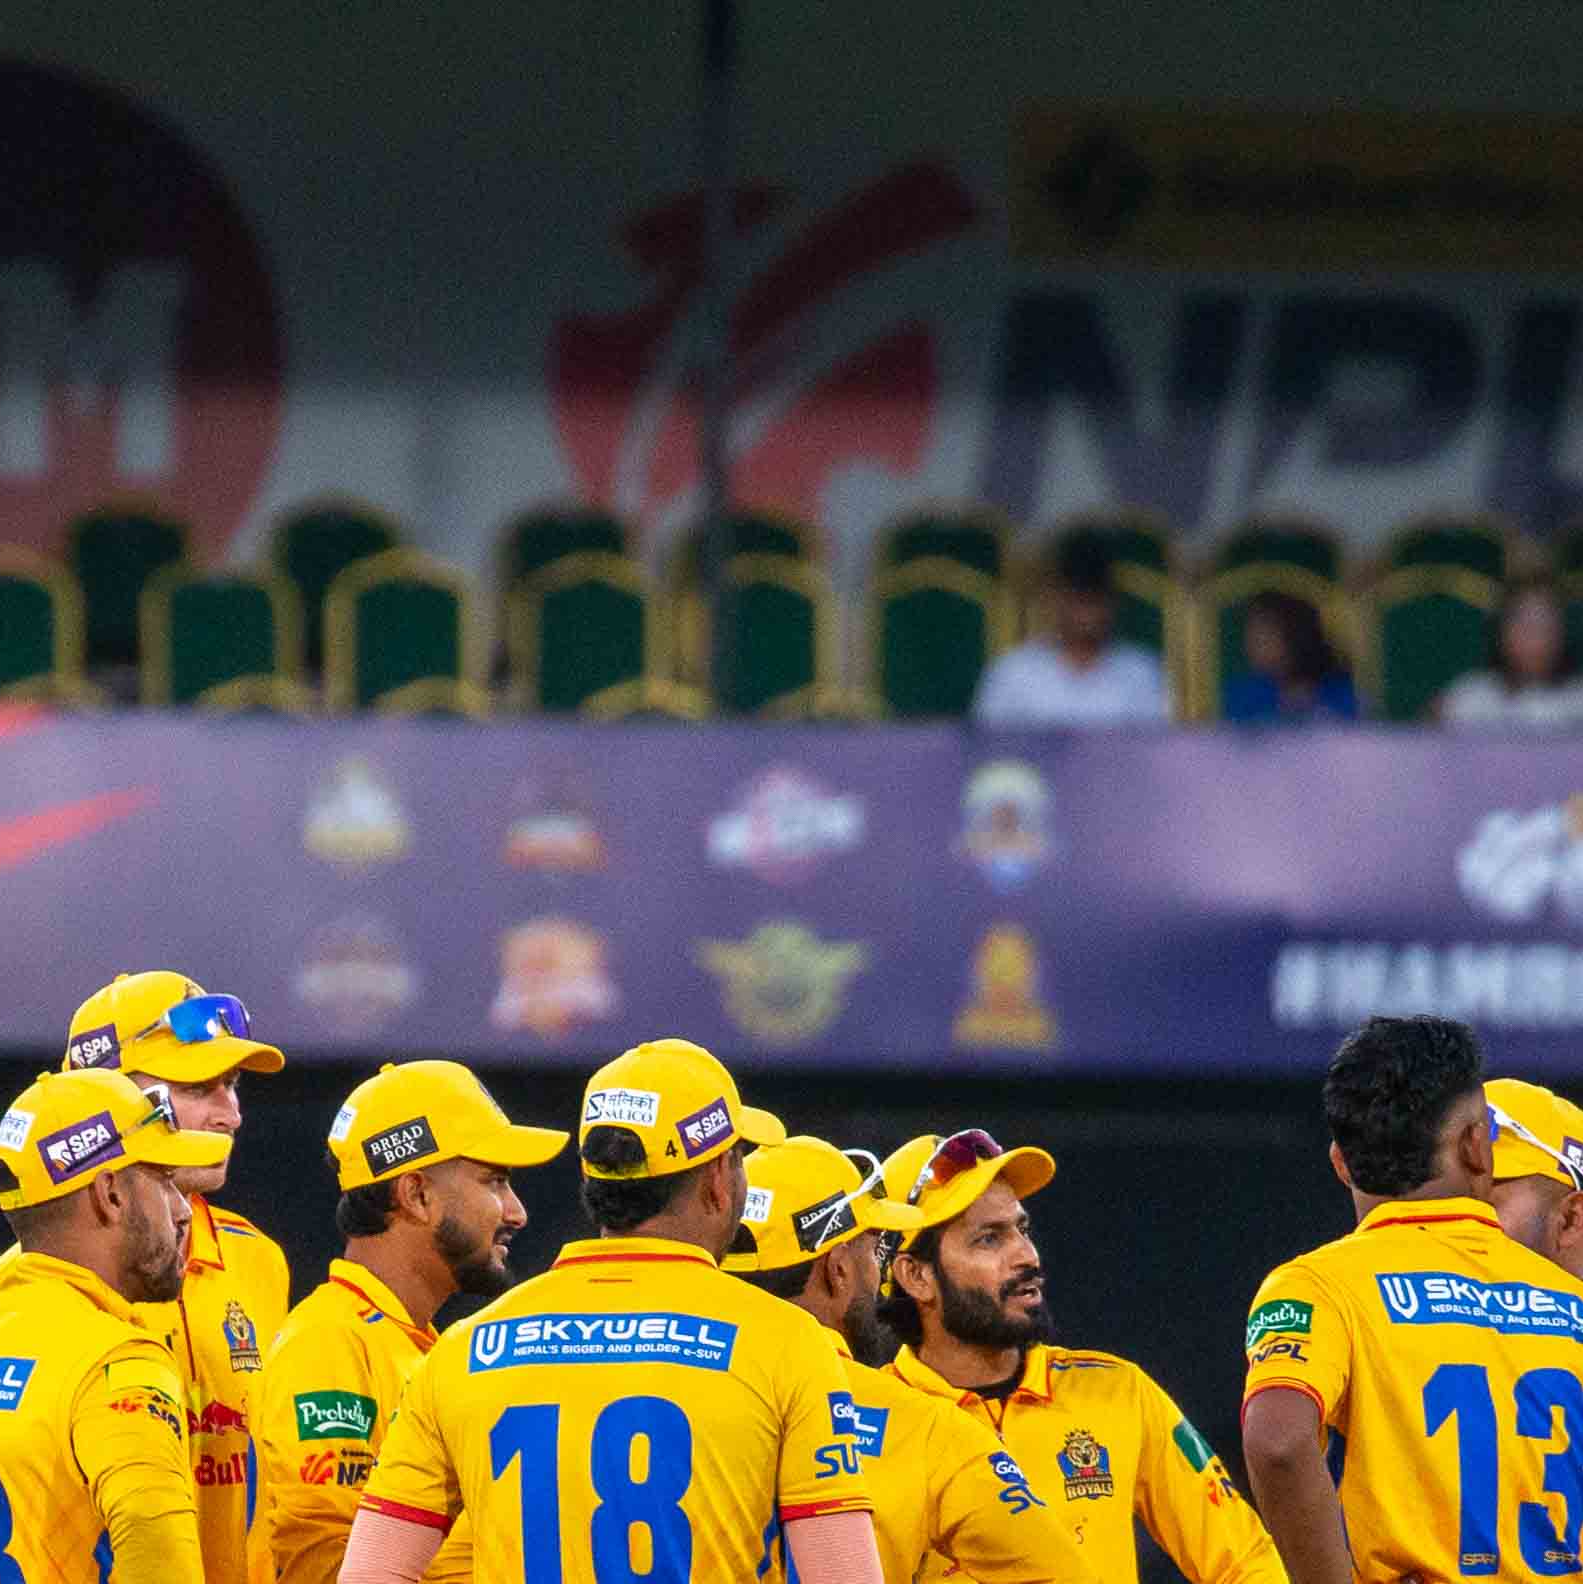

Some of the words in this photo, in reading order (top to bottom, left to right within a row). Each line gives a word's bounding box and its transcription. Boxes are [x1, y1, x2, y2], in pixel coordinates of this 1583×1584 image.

[82, 1035, 113, 1059] SPA
[703, 1107, 729, 1132] SPA
[69, 1124, 112, 1154] SPA
[370, 1125, 424, 1156] BREAD
[665, 1139, 678, 1158] 4
[384, 1141, 419, 1164] BOX
[514, 1318, 727, 1348] SKYWELL
[513, 1345, 558, 1356] NEPAL'S
[561, 1344, 604, 1355] BIGGER
[607, 1344, 631, 1353] AND
[635, 1343, 680, 1354] BOLDER
[1067, 1481, 1114, 1500] ROYALS
